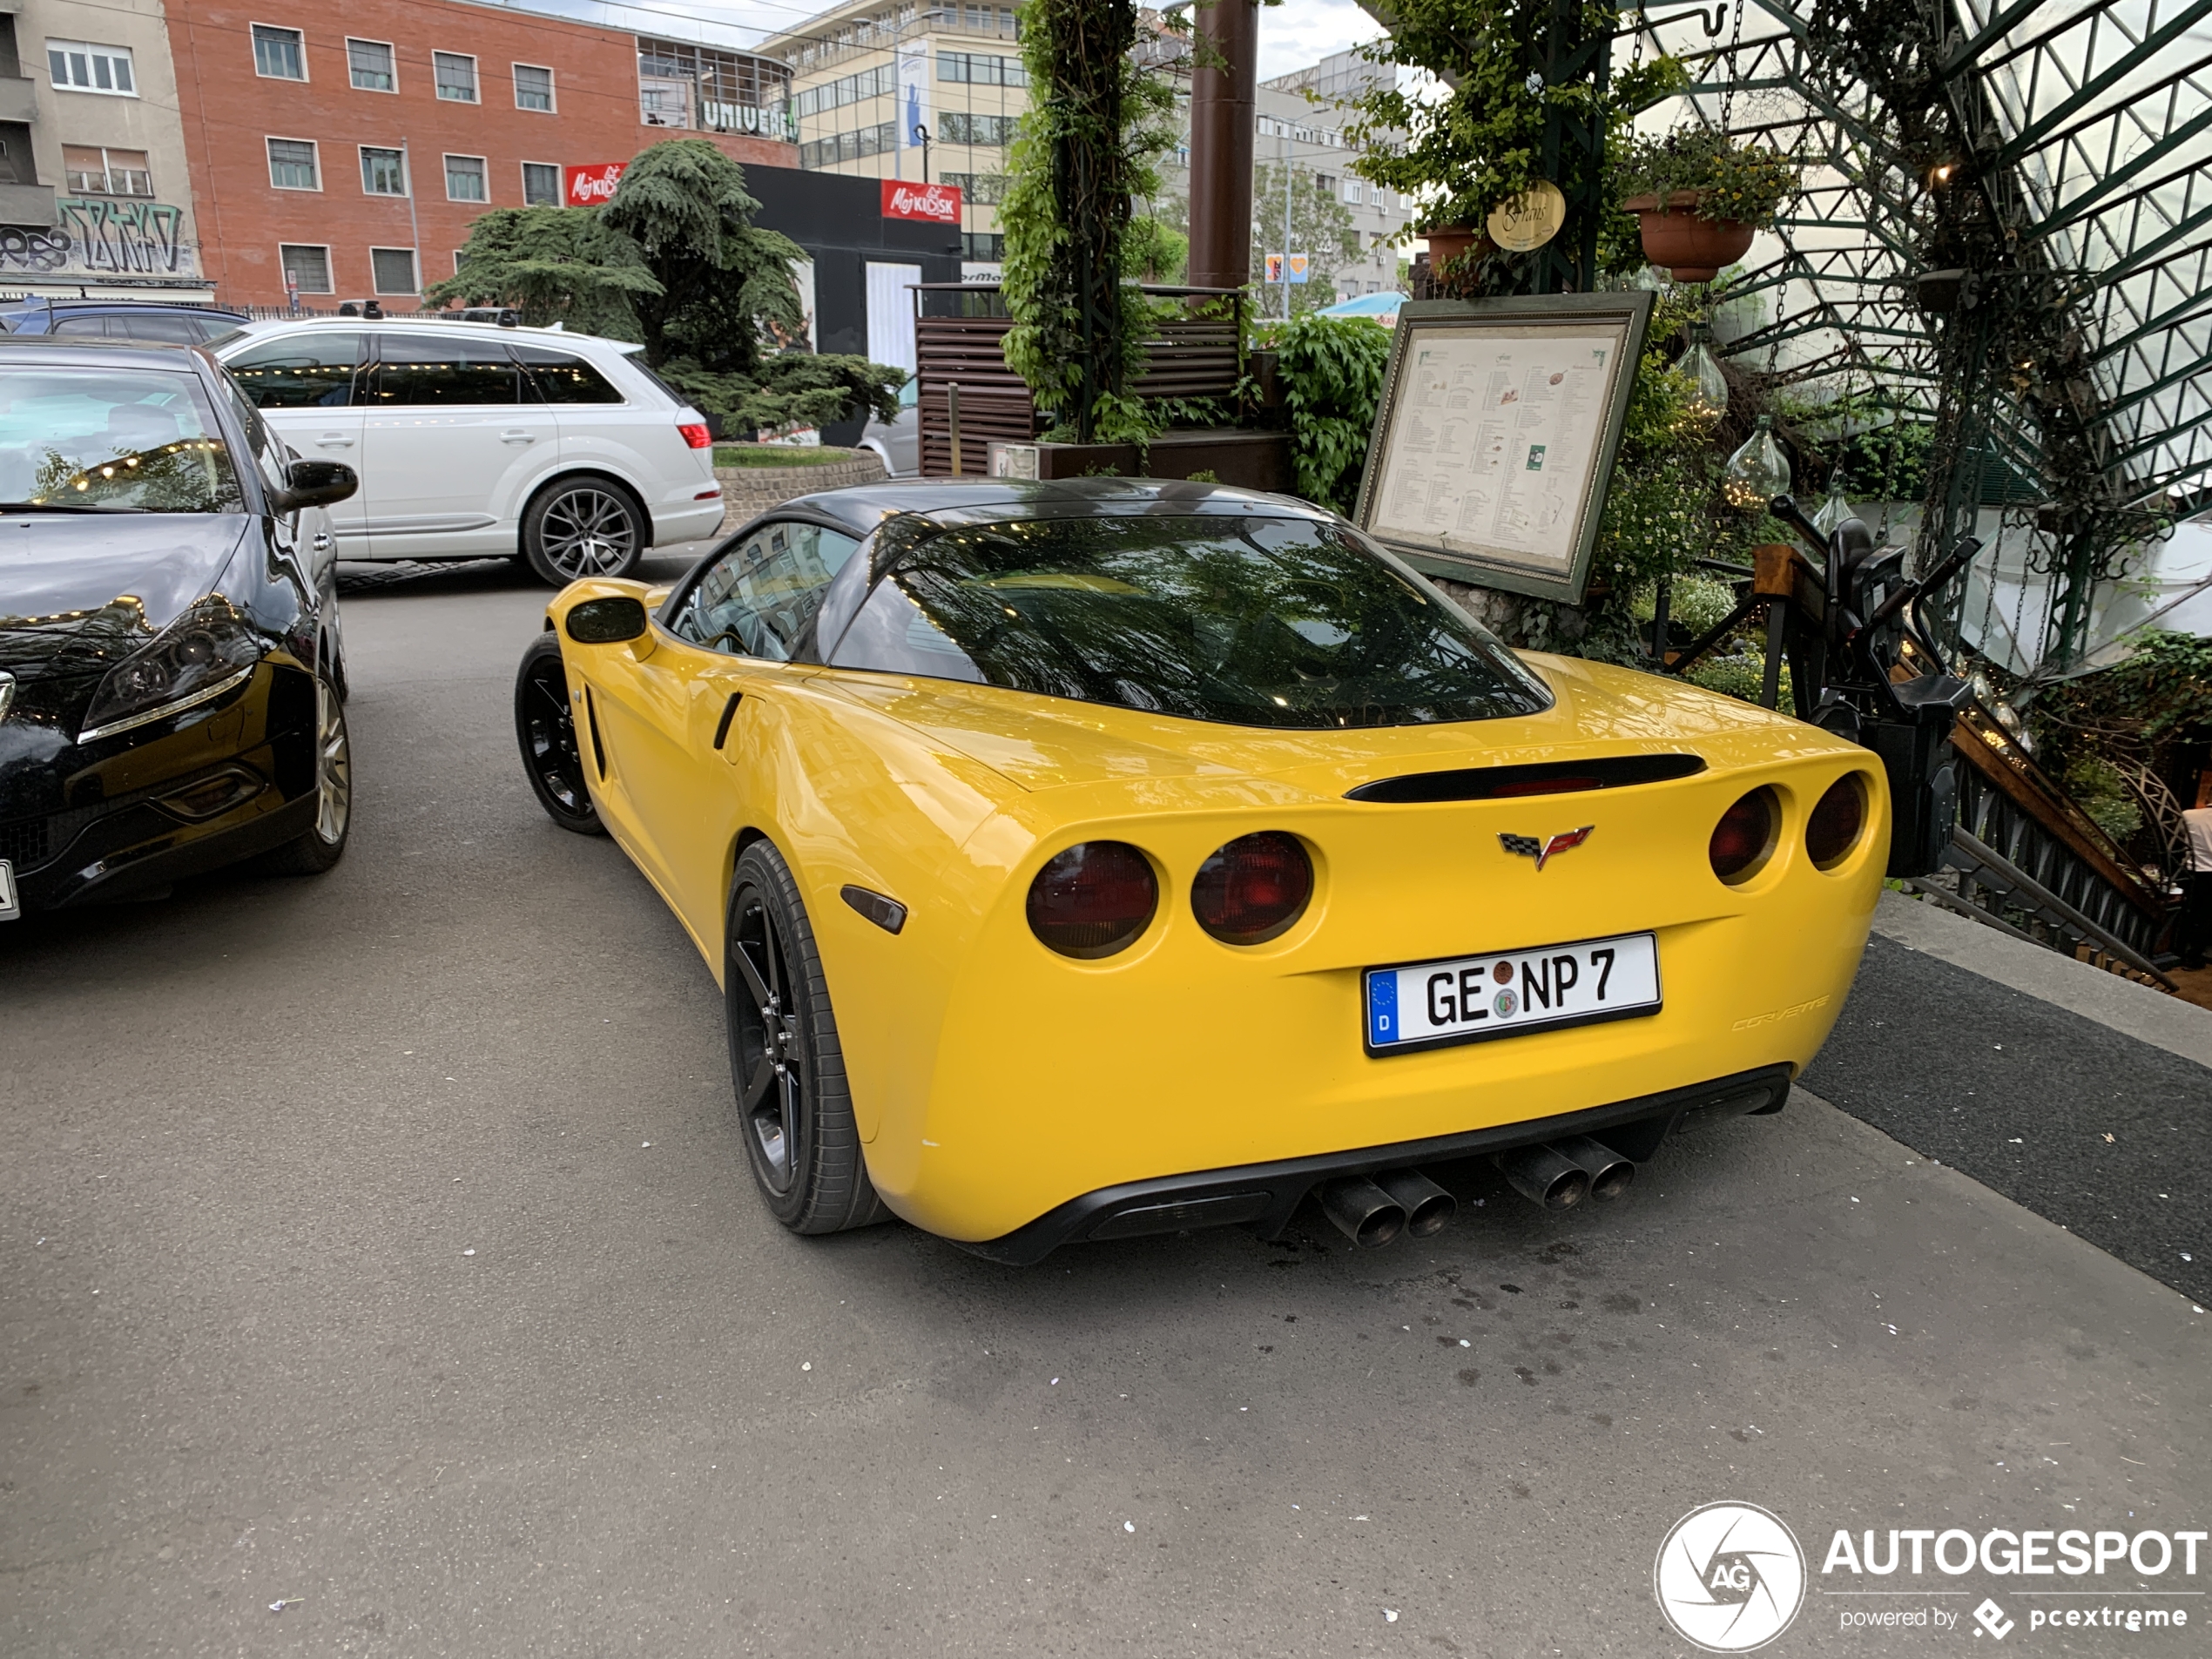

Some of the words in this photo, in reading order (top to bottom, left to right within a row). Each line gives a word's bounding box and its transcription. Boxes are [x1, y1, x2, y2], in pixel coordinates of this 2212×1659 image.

[890, 187, 914, 215] Moj
[914, 191, 954, 217] KIOSK
[1426, 967, 1488, 1026] GE
[1521, 954, 1578, 1012] NP
[1590, 948, 1615, 1001] 7
[1379, 1015, 1391, 1031] D
[1730, 995, 1830, 1031] CORVETTE
